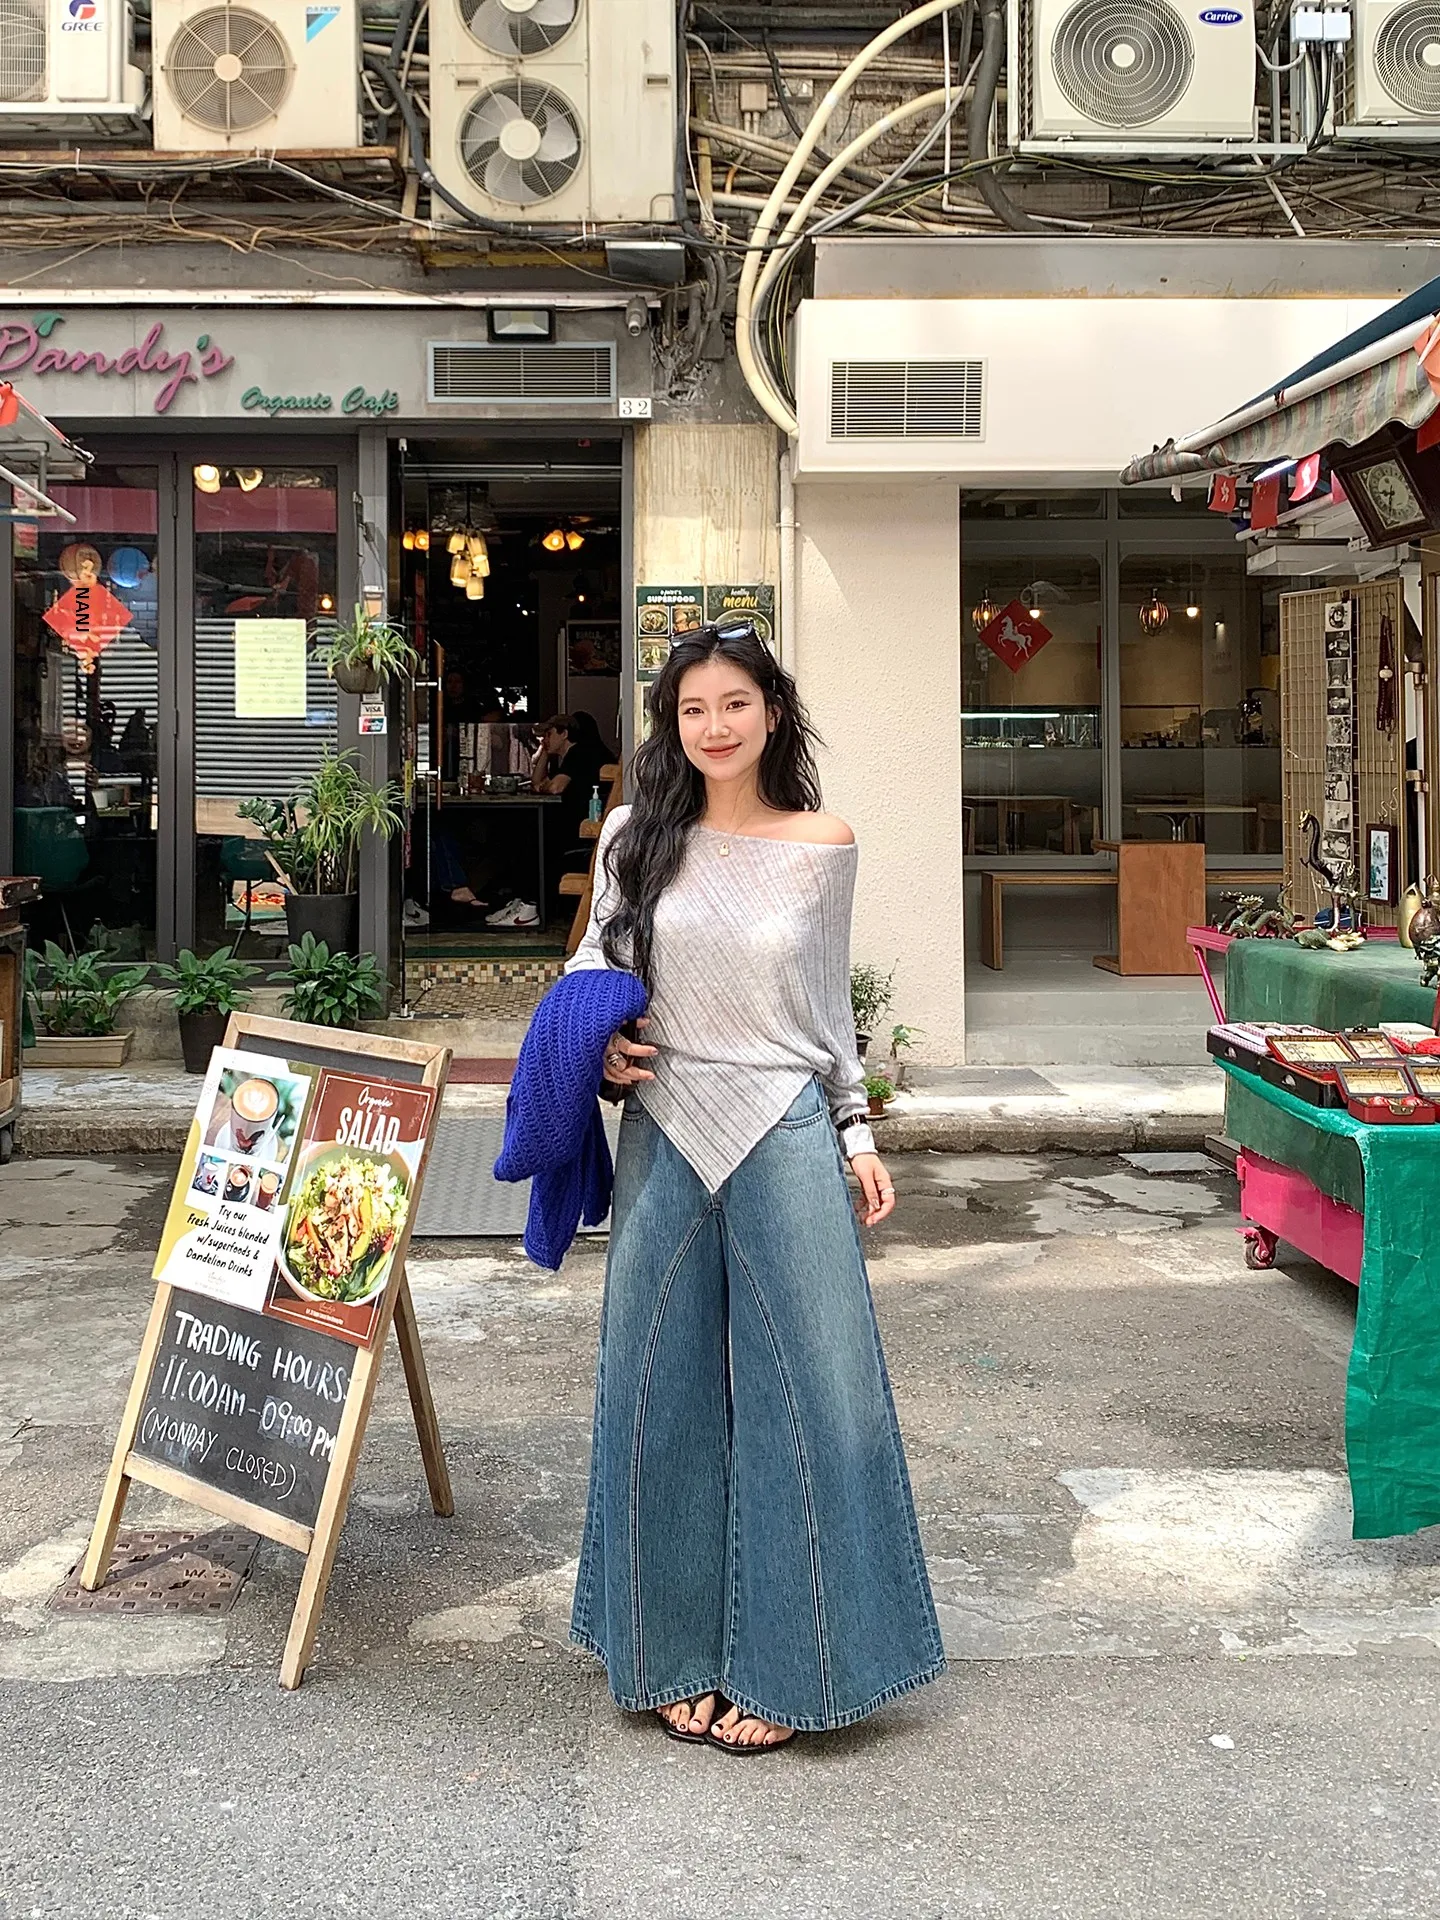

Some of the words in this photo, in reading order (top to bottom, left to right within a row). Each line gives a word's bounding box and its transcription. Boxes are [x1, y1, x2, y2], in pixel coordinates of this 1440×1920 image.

[61, 21, 104, 32] GREE
[1204, 11, 1238, 21] Carrier
[240, 386, 333, 417] Organic
[341, 385, 399, 417] Café
[646, 595, 696, 604] SUPERFOOD
[722, 595, 759, 609] menu
[364, 705, 382, 713] VISA
[335, 1106, 401, 1155] SALAD
[218, 1205, 232, 1220] Try
[233, 1211, 248, 1222] our
[187, 1213, 210, 1228] Fresh
[211, 1220, 237, 1237] Juices
[238, 1226, 270, 1245] blended
[196, 1233, 252, 1258] w/superfoods
[252, 1250, 261, 1261] &
[186, 1247, 228, 1268] Dandelion
[227, 1259, 253, 1278] Drinks
[174, 1310, 262, 1371] TRADING
[140, 1407, 219, 1463] (MONDAY
[225, 1446, 298, 1501] CLOSED)
